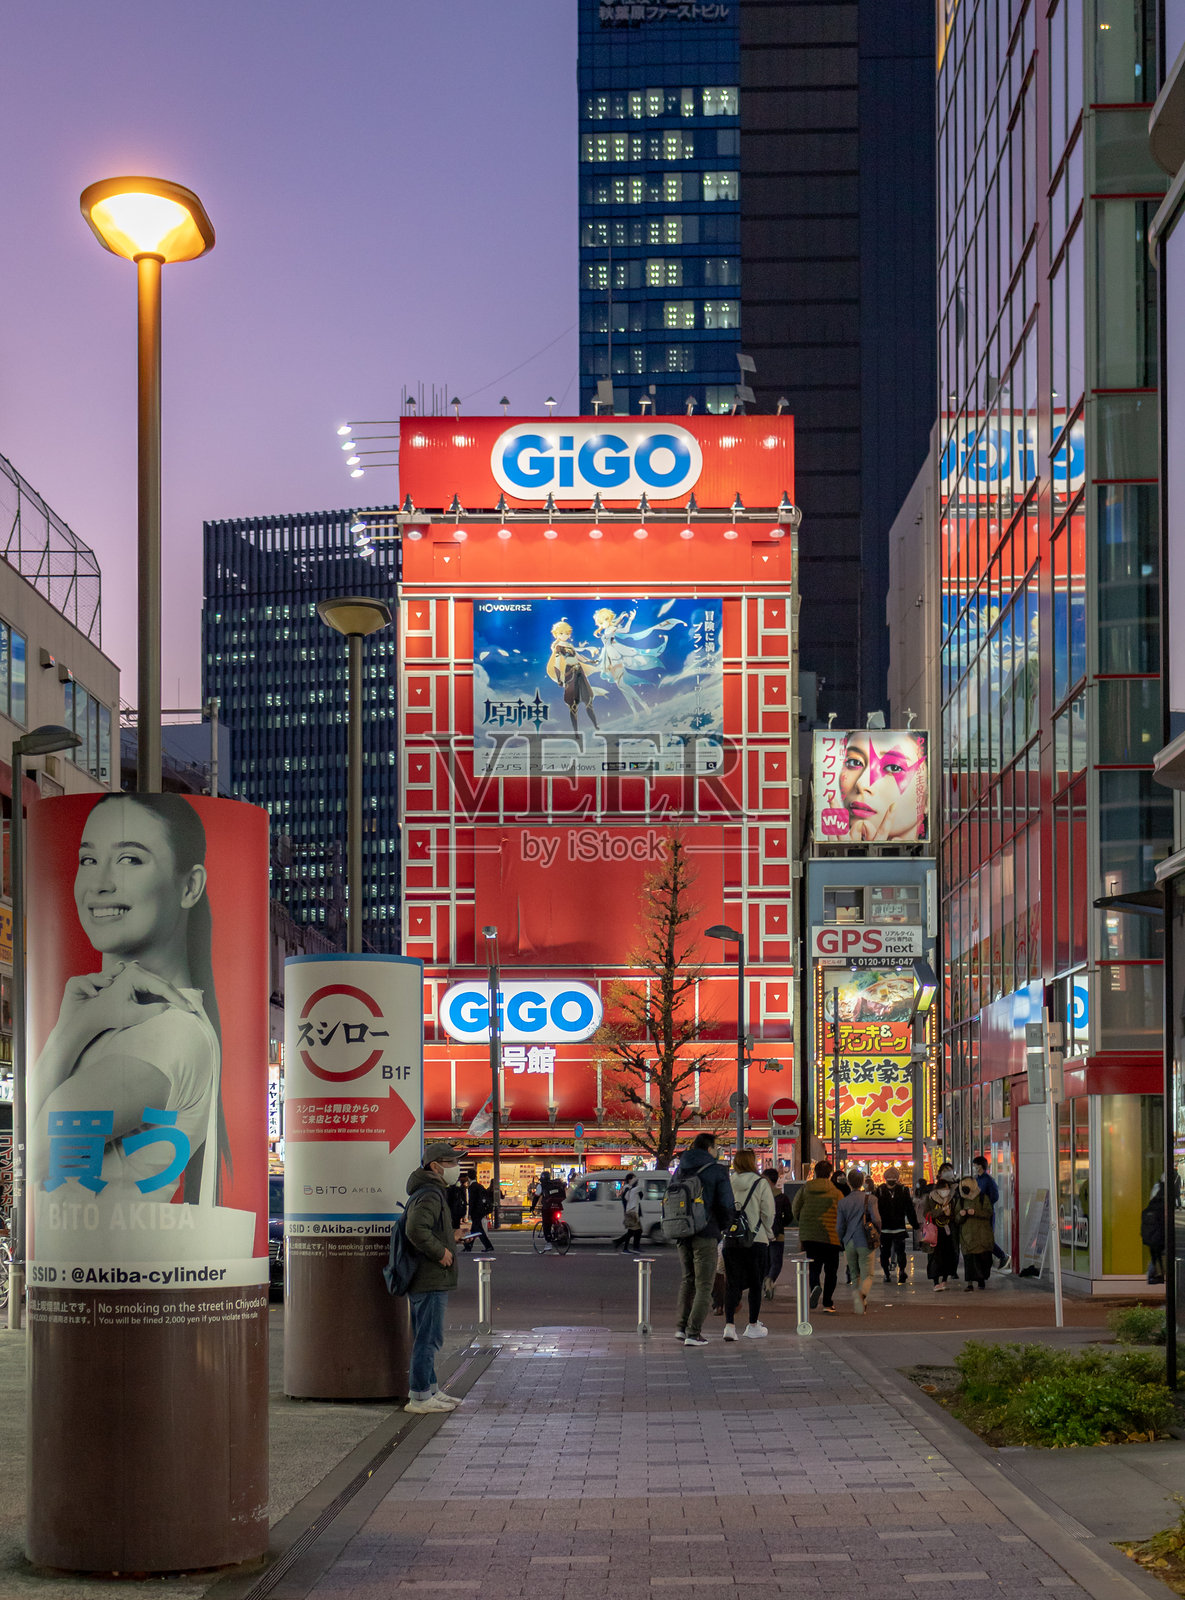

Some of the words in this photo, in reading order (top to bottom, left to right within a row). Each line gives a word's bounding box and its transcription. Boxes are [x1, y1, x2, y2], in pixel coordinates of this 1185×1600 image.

[598, 4, 729, 21] 秋葉原ファーストビル
[502, 433, 692, 488] GiGO
[478, 603, 532, 613] HOYOVERSE
[481, 688, 549, 733] 原神
[822, 737, 837, 804] ワクワク
[816, 929, 883, 954] GPS
[885, 943, 914, 953] next
[858, 958, 914, 966] 0120-915-047
[296, 1019, 390, 1048] スシロー
[497, 1046, 556, 1074] 号館
[381, 1066, 411, 1080] B1F
[295, 1103, 380, 1114] スシローは階段からの
[825, 1085, 912, 1117] ラーメン
[301, 1114, 369, 1124] ご来店となります
[43, 1106, 191, 1195] 買う
[0, 1136, 13, 1215] コインロッカー
[315, 1185, 348, 1195] BiTO
[51, 1202, 99, 1231] BiTO
[110, 1202, 196, 1230] AKIBA
[288, 1224, 305, 1233] SSID
[312, 1223, 392, 1235] @Akiba-cylind
[32, 1266, 58, 1283] SSID
[71, 1265, 227, 1284] @Akiba-cylinder
[98, 1303, 113, 1314] No
[115, 1302, 160, 1316] smoking
[162, 1303, 177, 1313] on
[178, 1301, 196, 1313] the
[197, 1300, 224, 1312] street
[226, 1299, 234, 1310] in
[235, 1297, 260, 1312] Chiyoda
[98, 1316, 114, 1325] You
[115, 1316, 130, 1324] will
[131, 1316, 141, 1324] be
[143, 1316, 163, 1324] fined
[165, 1315, 186, 1325] 2,000
[187, 1316, 200, 1325] yen
[201, 1315, 207, 1323] if
[208, 1314, 221, 1323] you
